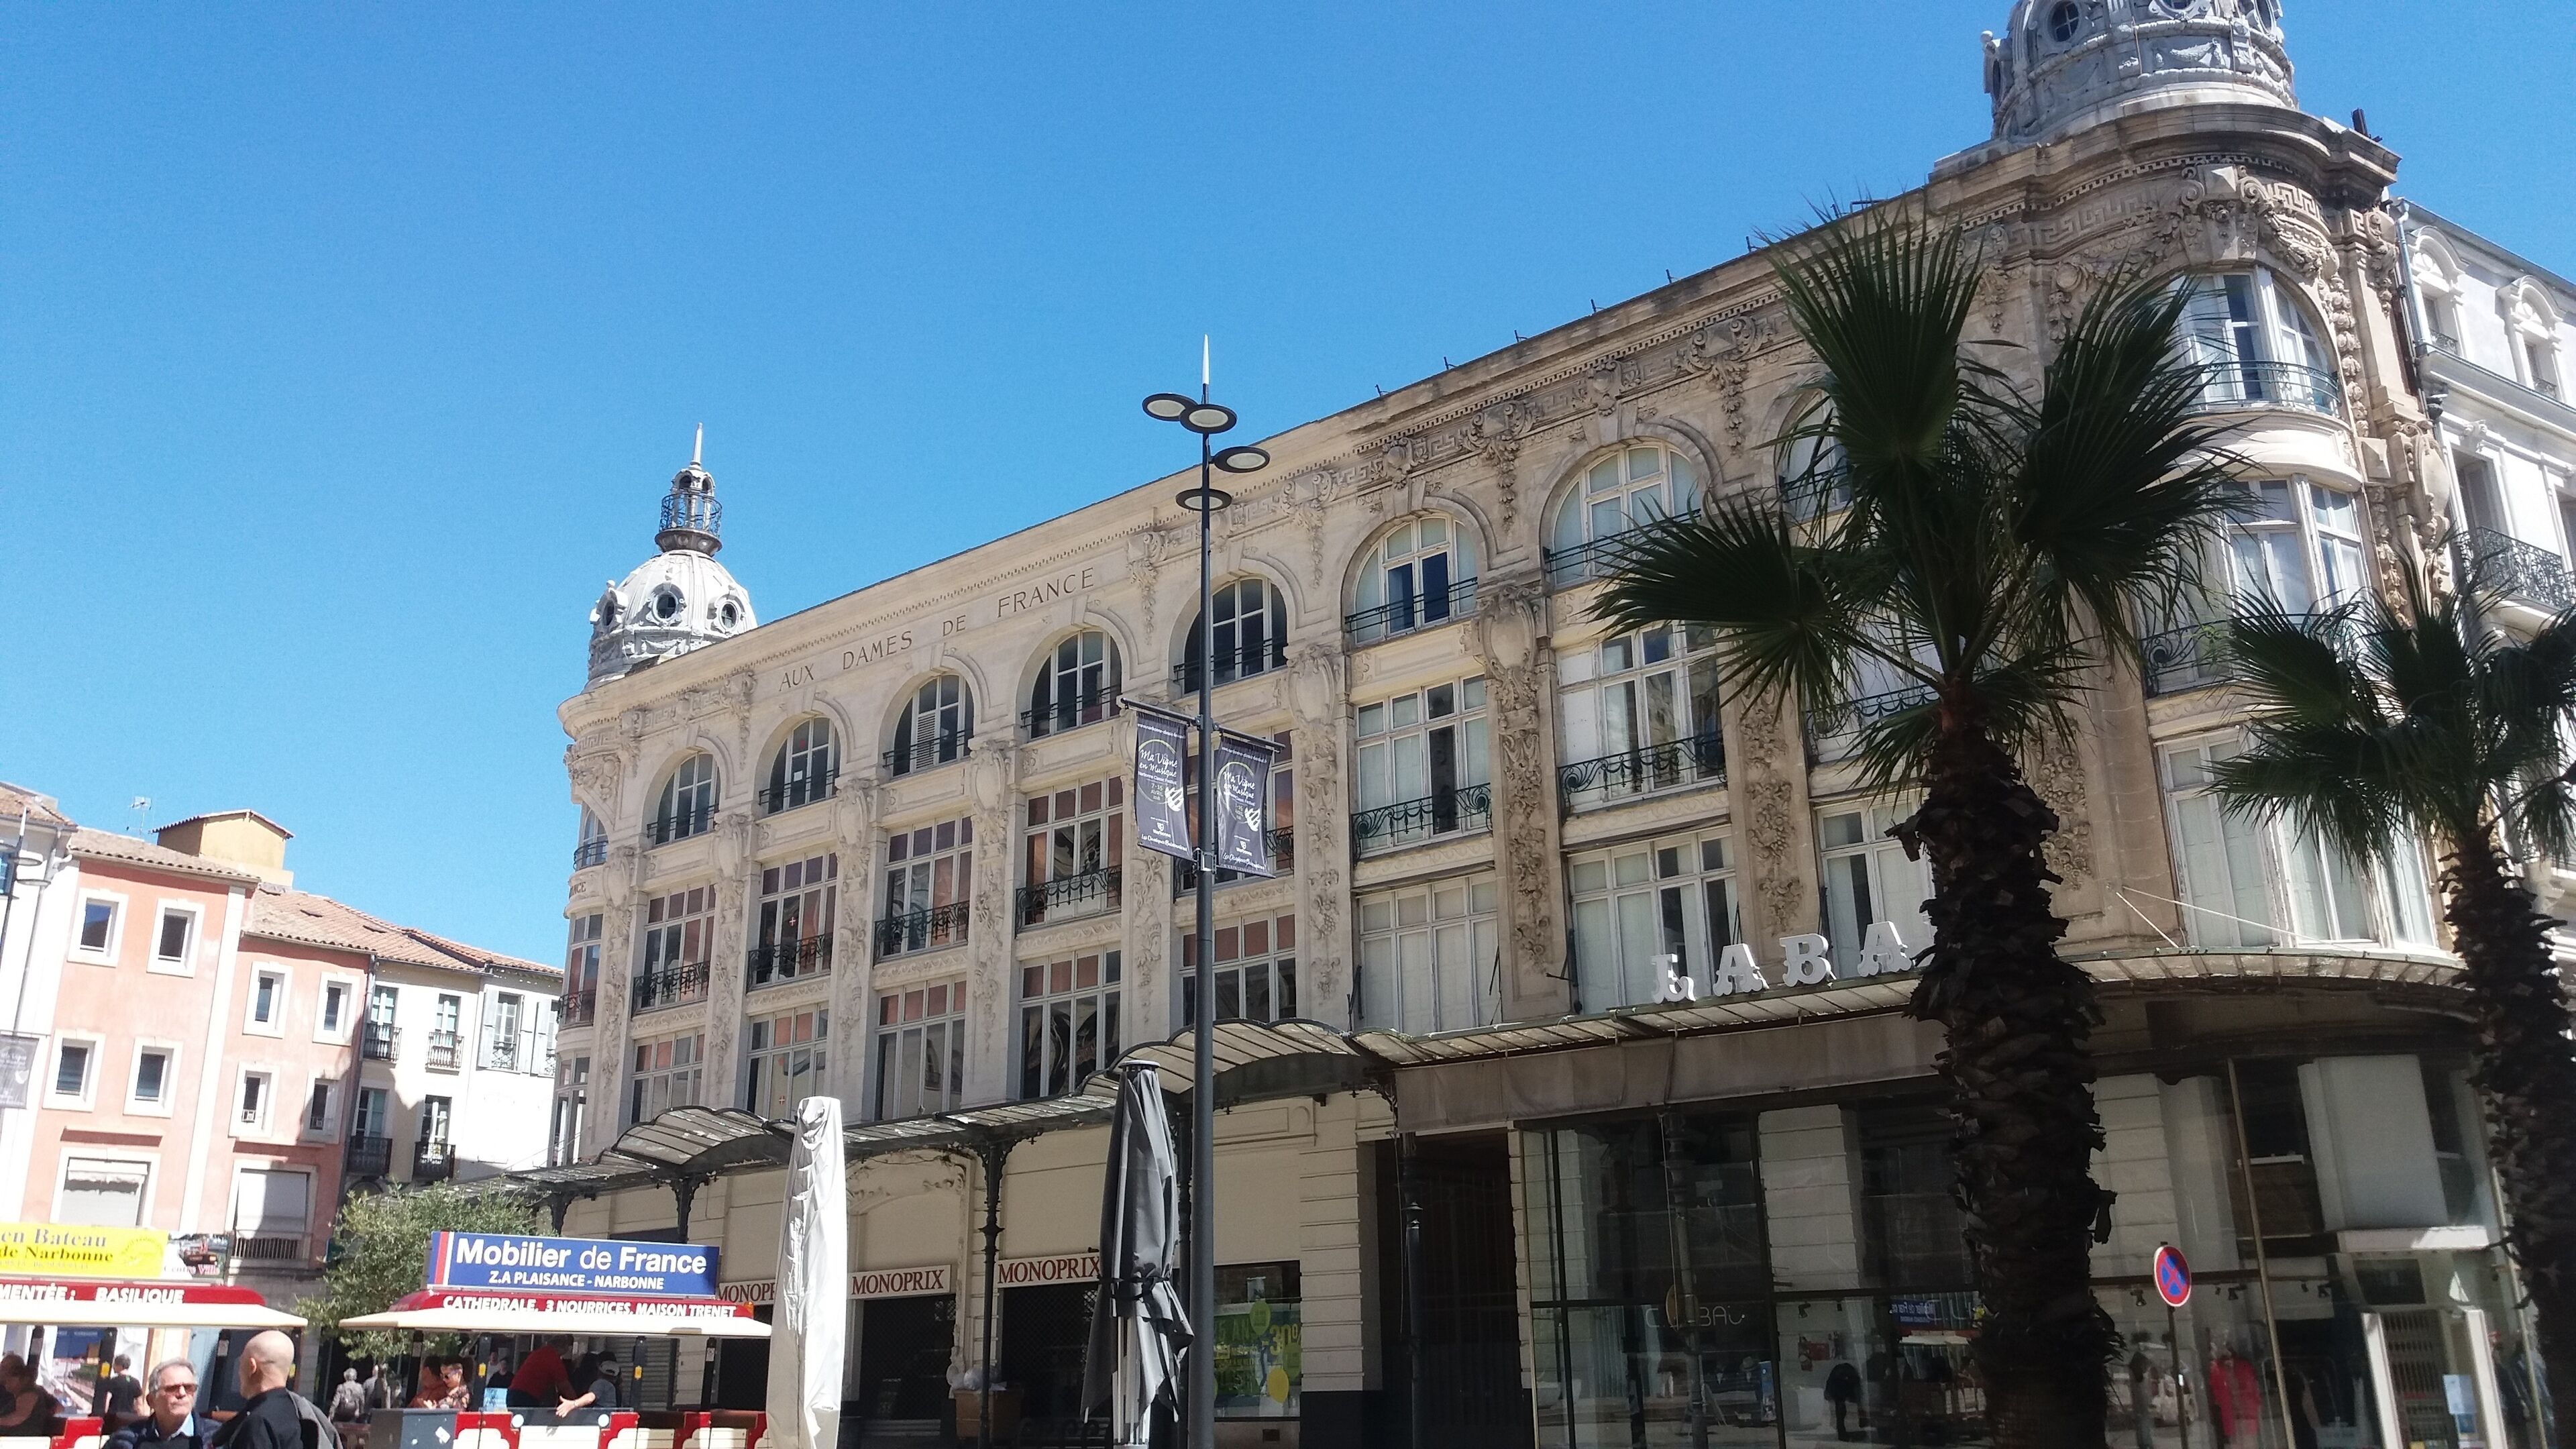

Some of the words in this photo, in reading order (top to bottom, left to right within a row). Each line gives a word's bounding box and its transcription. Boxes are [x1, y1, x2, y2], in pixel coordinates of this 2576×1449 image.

[779, 663, 814, 692] AUX
[843, 631, 912, 670] DAMES
[943, 614, 966, 637] DE
[998, 567, 1094, 618] FRANCE
[1149, 763, 1177, 778] Musique
[1155, 753, 1178, 770] Vigne
[1236, 775, 1256, 792] Vigne
[35, 1228, 107, 1247] Bateau
[25, 1246, 113, 1262] Narbonne
[456, 1238, 571, 1268] Mobilier
[580, 1245, 611, 1270] de
[619, 1246, 706, 1274] France
[998, 1256, 1099, 1283] MONOPRIX
[488, 1271, 511, 1284] Z.A
[514, 1271, 585, 1287] PLAISANCE
[594, 1275, 664, 1289] NARBONNE
[852, 1269, 945, 1295] MONOPRIX
[95, 1287, 184, 1303] BASILIQUE
[545, 1299, 554, 1313] 3
[636, 1303, 688, 1317] MAISON
[689, 1305, 737, 1318] TRENET
